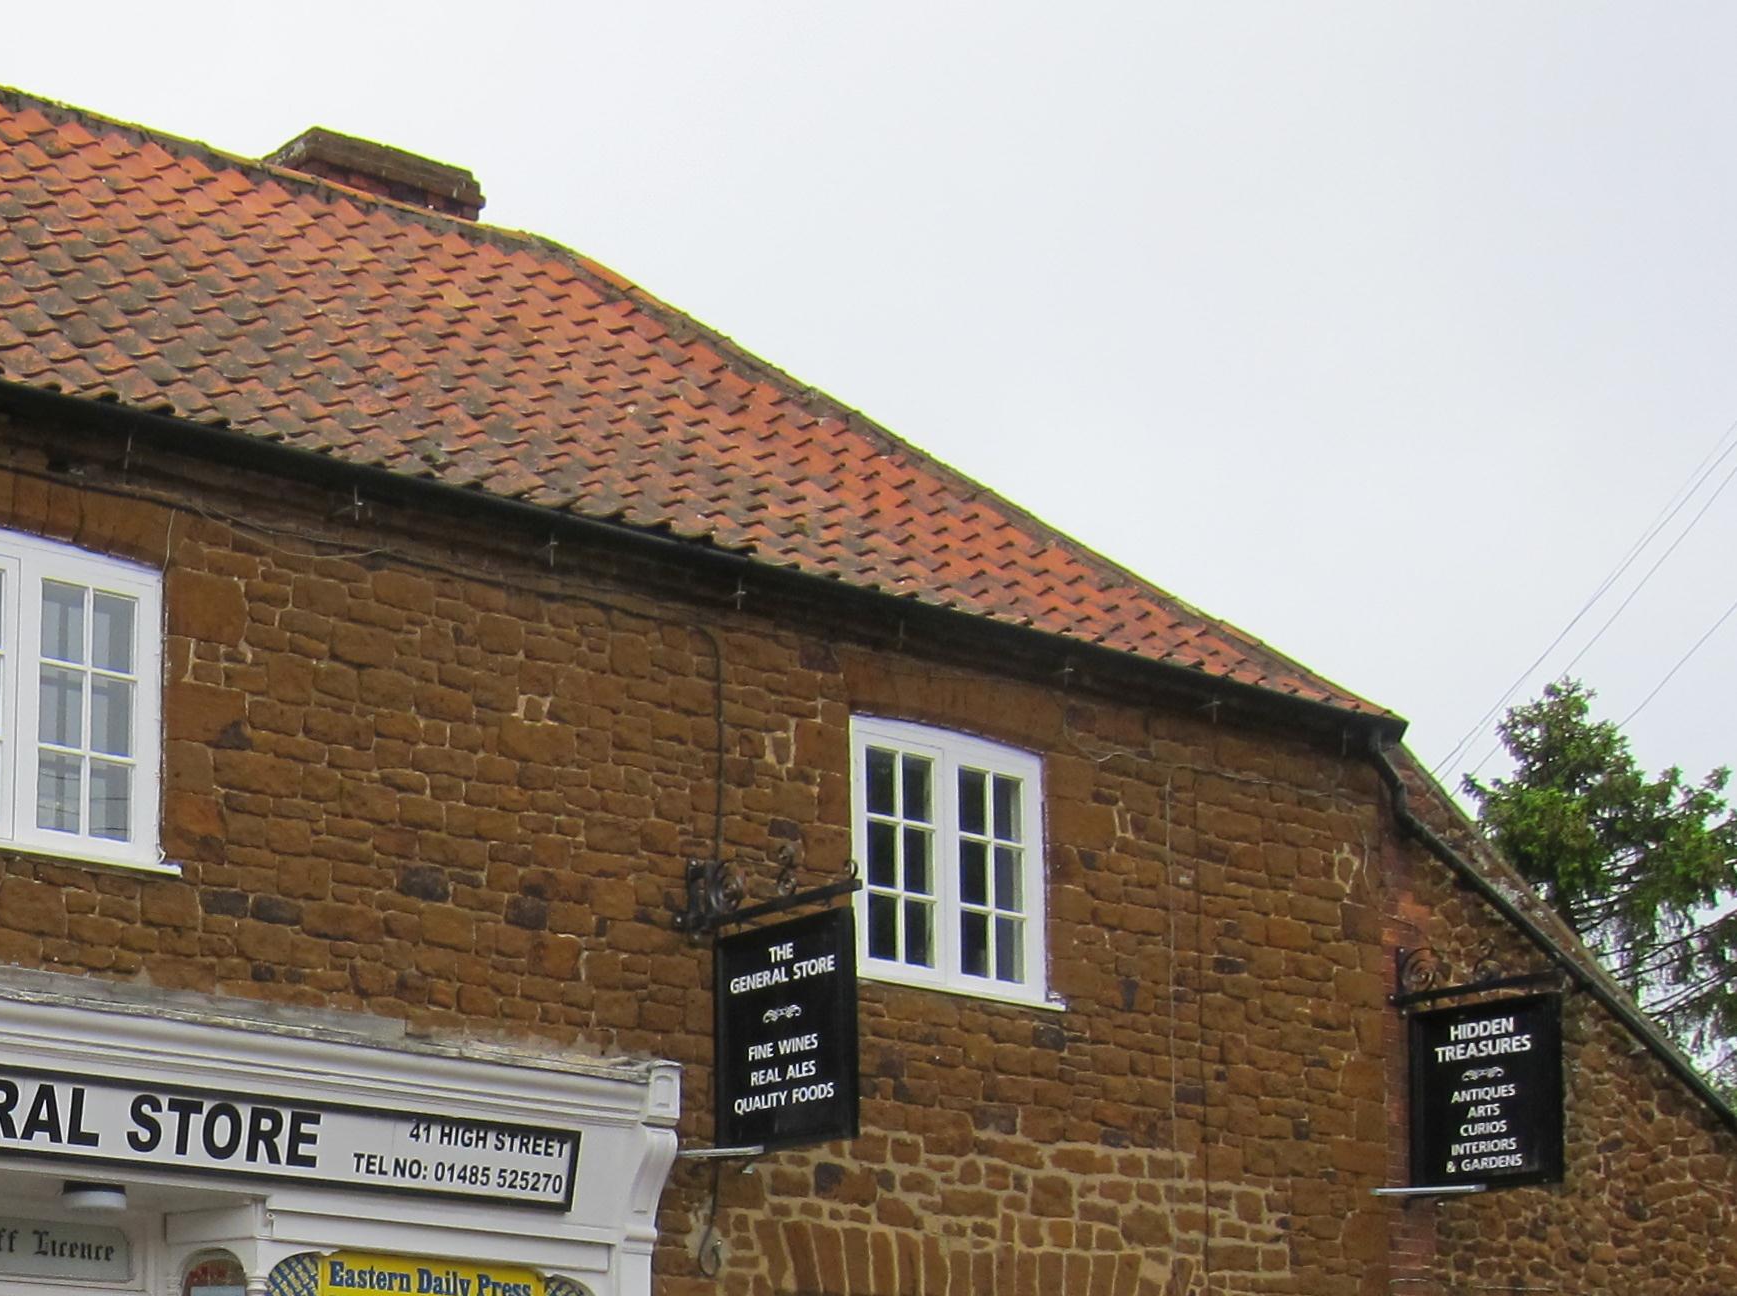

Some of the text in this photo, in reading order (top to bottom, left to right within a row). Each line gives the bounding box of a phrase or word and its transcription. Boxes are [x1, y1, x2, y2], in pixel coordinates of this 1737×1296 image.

[768, 942, 794, 963] THE
[730, 954, 835, 994] GENERAL STORE
[1450, 1017, 1514, 1041] HIDDEN
[748, 1033, 818, 1062] FINE WINES
[1434, 1034, 1532, 1063] TREASURES
[750, 1060, 816, 1087] REAL ALES
[734, 1081, 835, 1115] QUALITY FOODS
[1451, 1084, 1516, 1104] ANTIQUES
[1467, 1103, 1501, 1119] ARTS
[126, 1094, 321, 1168] STORE
[409, 1122, 567, 1159] 41 HIGH STREET
[1460, 1120, 1507, 1137] CURIOS
[1451, 1137, 1517, 1156] INTERIORS
[353, 1153, 563, 1194] TEL NO: 01485 525270
[1446, 1154, 1523, 1173] & GARDENS
[32, 1230, 114, 1262] Licence
[329, 1260, 411, 1293] Eastern
